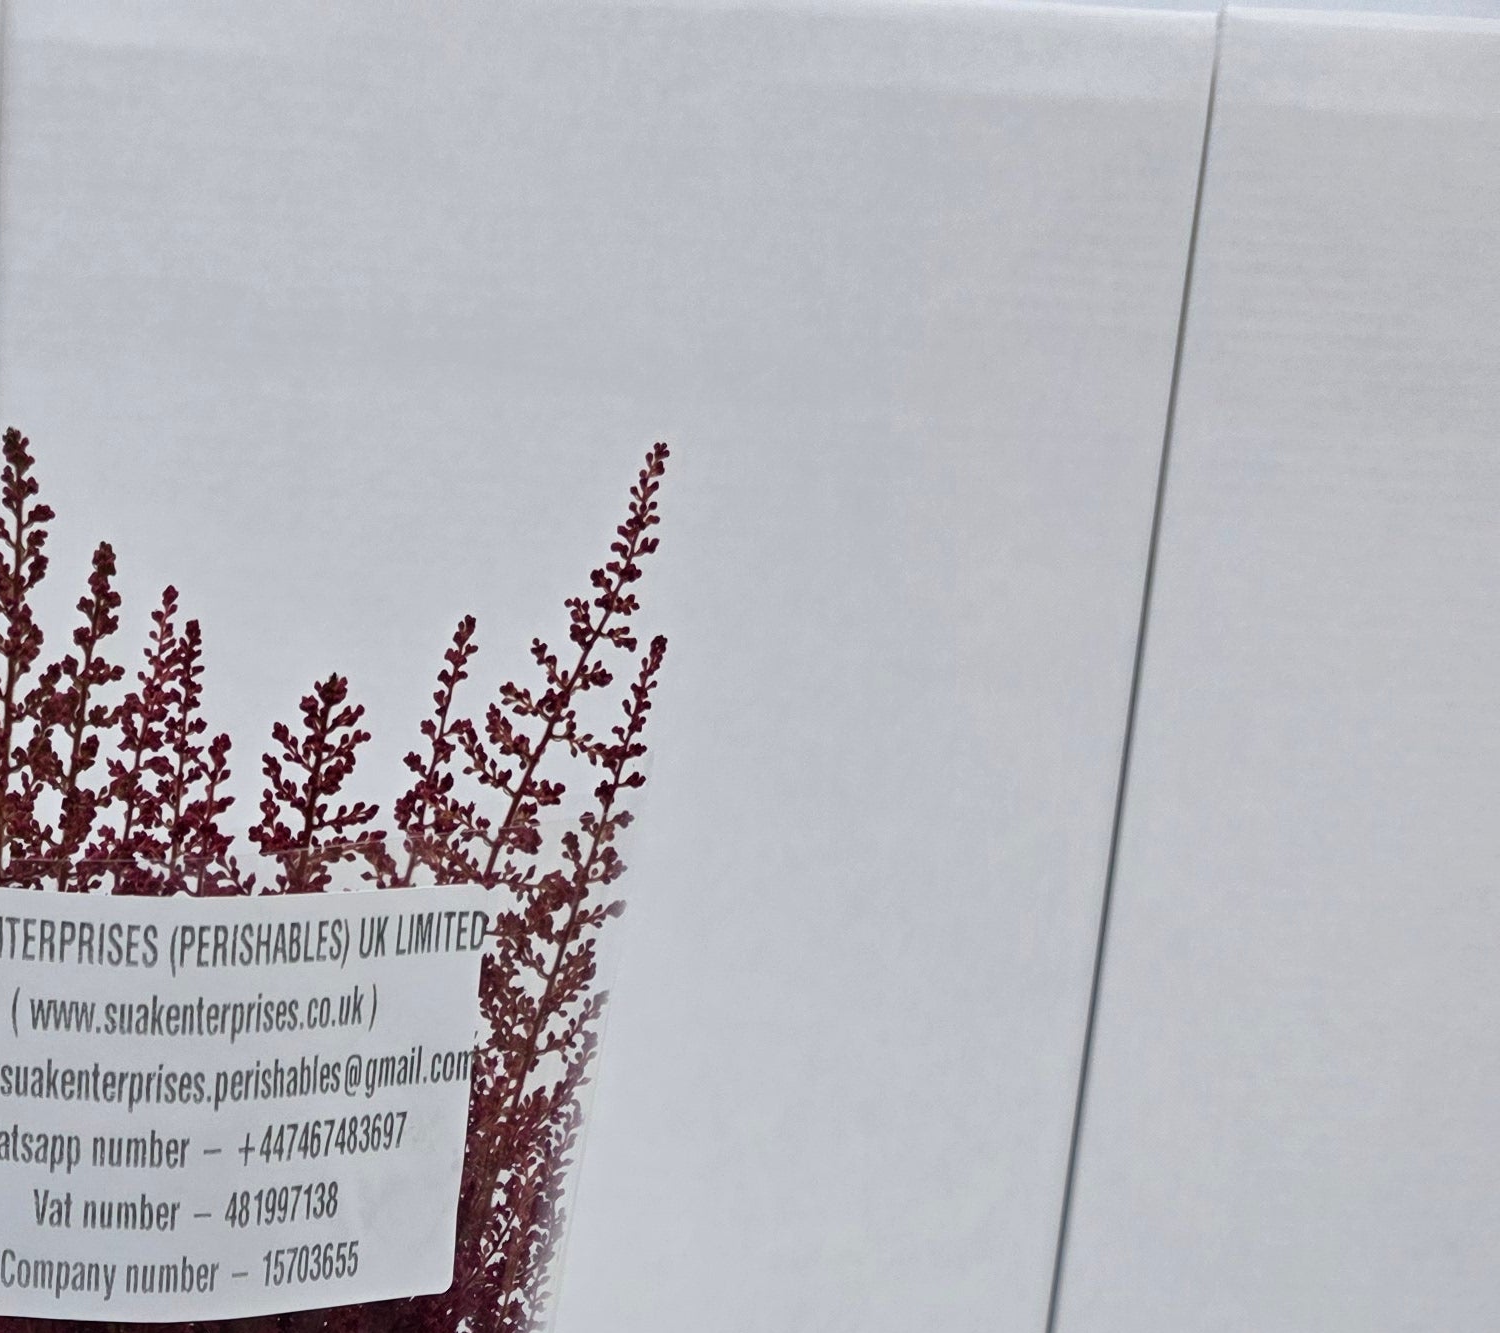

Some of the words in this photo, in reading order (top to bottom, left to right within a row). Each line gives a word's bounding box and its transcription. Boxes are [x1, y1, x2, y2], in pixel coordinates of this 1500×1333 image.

[169, 918, 351, 978] (PERISHABLES)
[358, 915, 389, 960] UK
[395, 910, 486, 957] LIMITED
[29, 985, 365, 1045] www.suakenterprises.co.uk
[92, 1129, 191, 1170] number
[237, 1110, 408, 1167] +447467483697
[33, 1188, 73, 1229] Vat
[82, 1192, 181, 1232] number
[224, 1180, 339, 1229] 481997138
[0, 1248, 117, 1302] Company
[125, 1255, 220, 1294] number
[262, 1239, 360, 1287] 15703655
